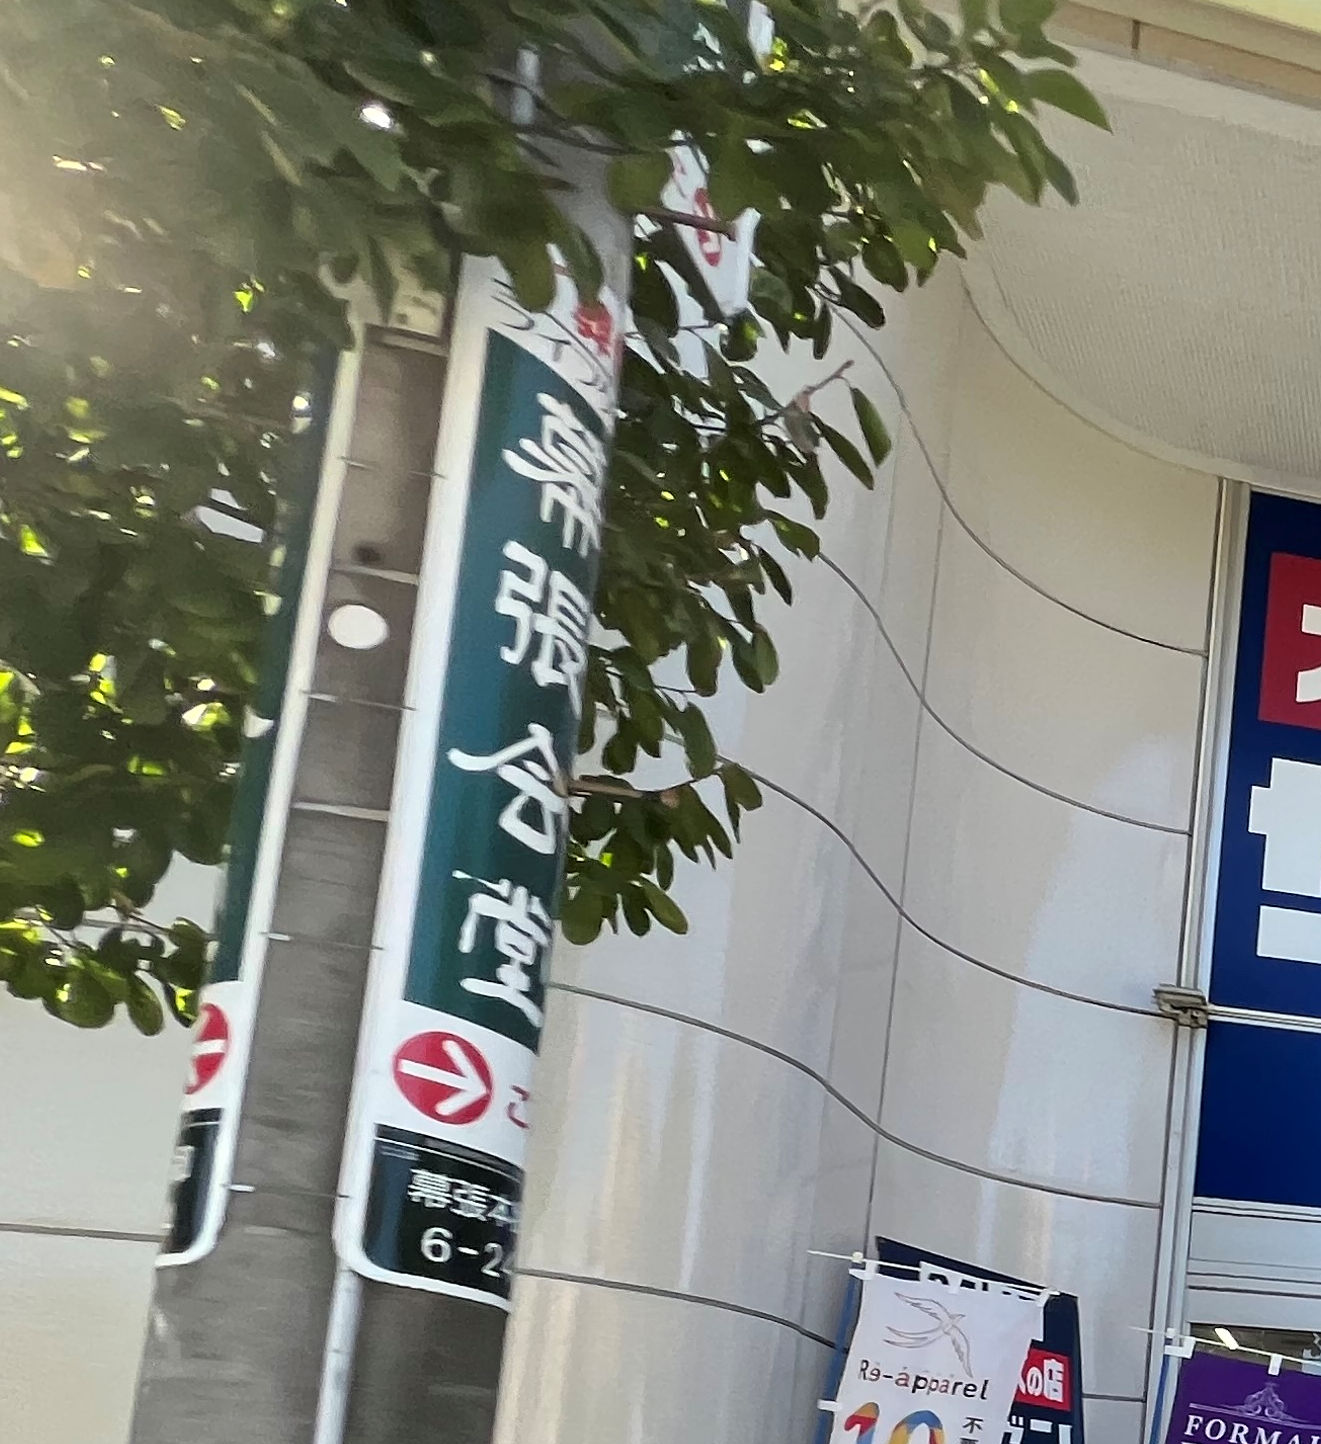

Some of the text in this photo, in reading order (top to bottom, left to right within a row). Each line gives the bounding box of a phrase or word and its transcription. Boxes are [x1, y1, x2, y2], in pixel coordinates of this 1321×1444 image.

[420, 1226, 513, 1279] 6-2
[859, 1358, 990, 1401] Re-apparel
[1018, 1358, 1065, 1403] の店
